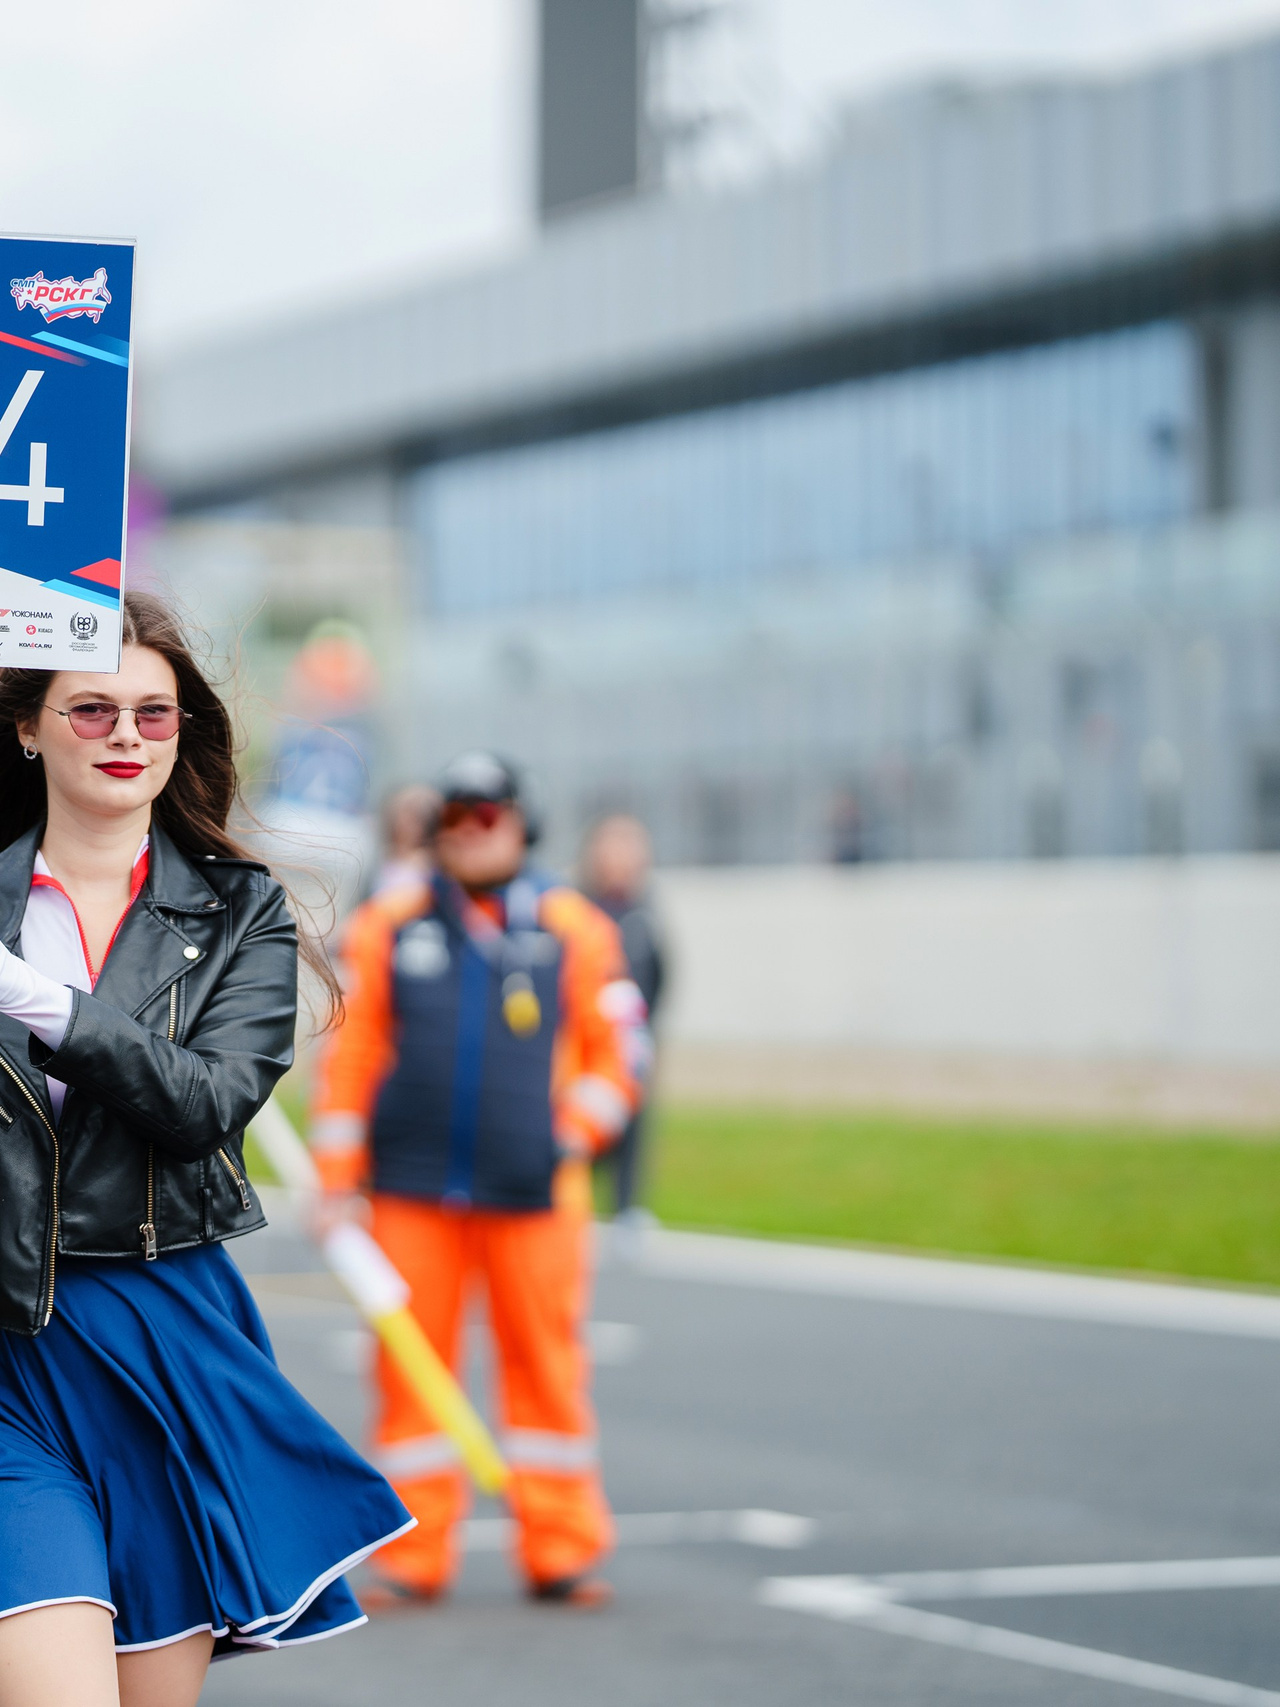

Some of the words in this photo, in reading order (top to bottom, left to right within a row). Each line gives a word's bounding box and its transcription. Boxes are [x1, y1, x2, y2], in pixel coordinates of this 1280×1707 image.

[11, 279, 35, 288] СМП
[34, 286, 93, 302] РСКГ
[11, 609, 53, 619] YOKOHAMA
